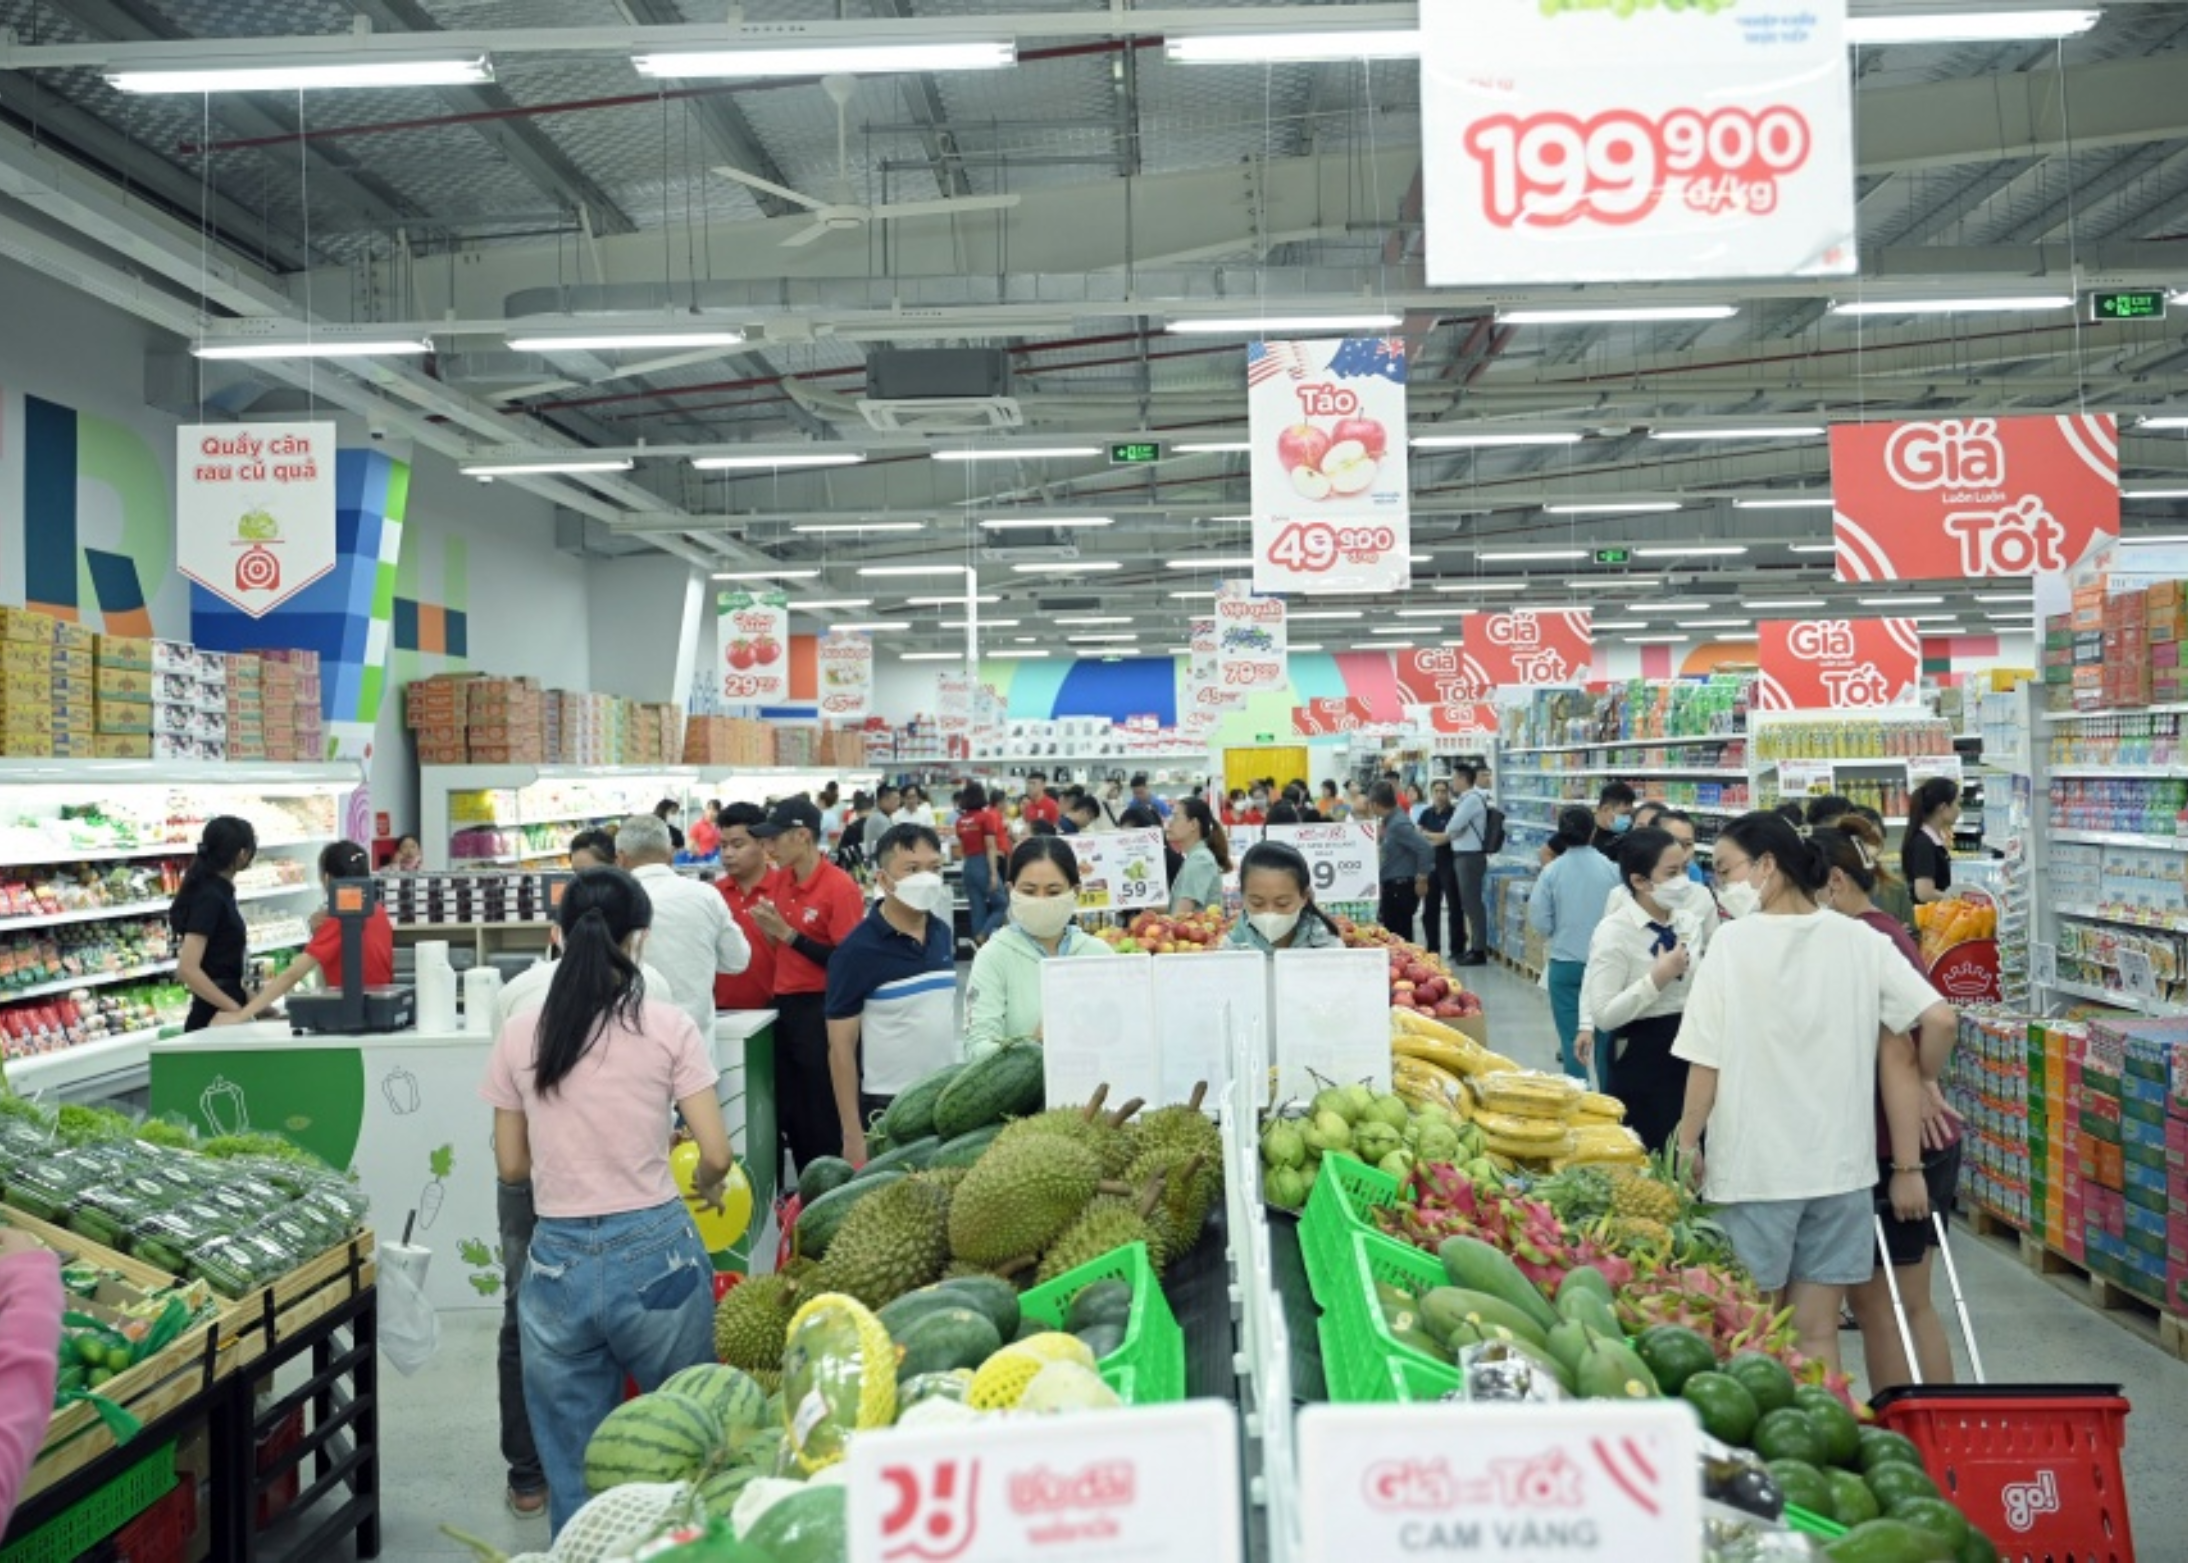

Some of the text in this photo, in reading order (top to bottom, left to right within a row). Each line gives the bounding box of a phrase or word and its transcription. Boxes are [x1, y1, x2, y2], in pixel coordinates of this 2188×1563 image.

[1465, 106, 1811, 227] 199 900
[1297, 383, 1357, 417] Táo
[196, 465, 232, 480] rau
[1884, 417, 2005, 491] Giá
[1268, 522, 1338, 573] 49
[1943, 495, 2067, 577] Tốt
[1485, 611, 1540, 645] Giá
[1787, 619, 1855, 660] Giá
[1414, 647, 1457, 673] Giá
[1511, 647, 1567, 684] Tốt
[1435, 675, 1479, 702] Tốt
[1819, 661, 1889, 708] Tốt
[1122, 881, 1147, 898] 59
[2001, 1469, 2060, 1533] go!
[1400, 1521, 1482, 1551] CAM
